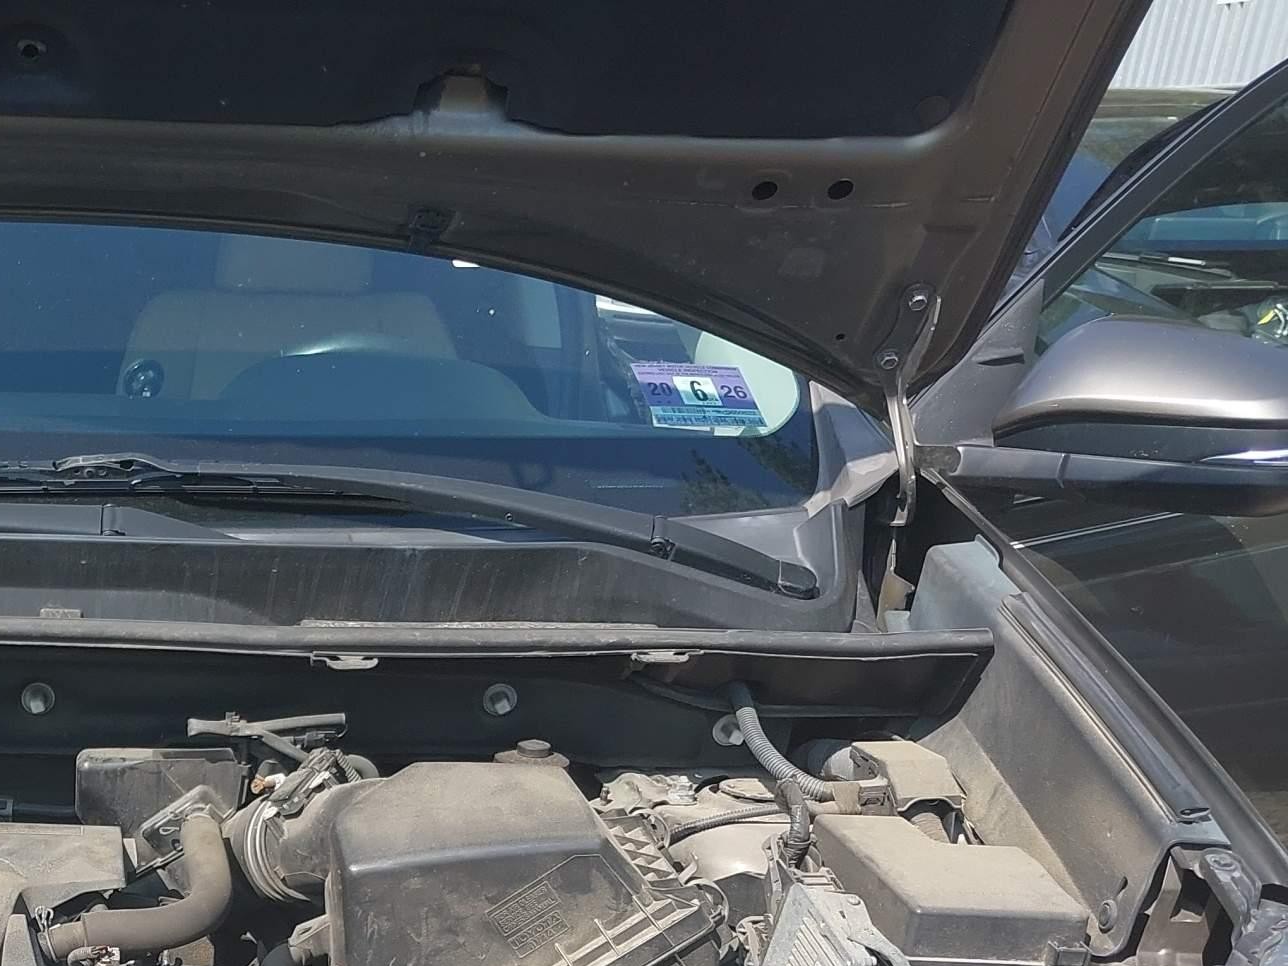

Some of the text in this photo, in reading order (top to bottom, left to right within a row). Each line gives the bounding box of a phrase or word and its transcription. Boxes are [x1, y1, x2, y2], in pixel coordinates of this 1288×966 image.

[647, 382, 673, 397] 20
[690, 380, 710, 402] 6
[720, 384, 749, 400] 26
